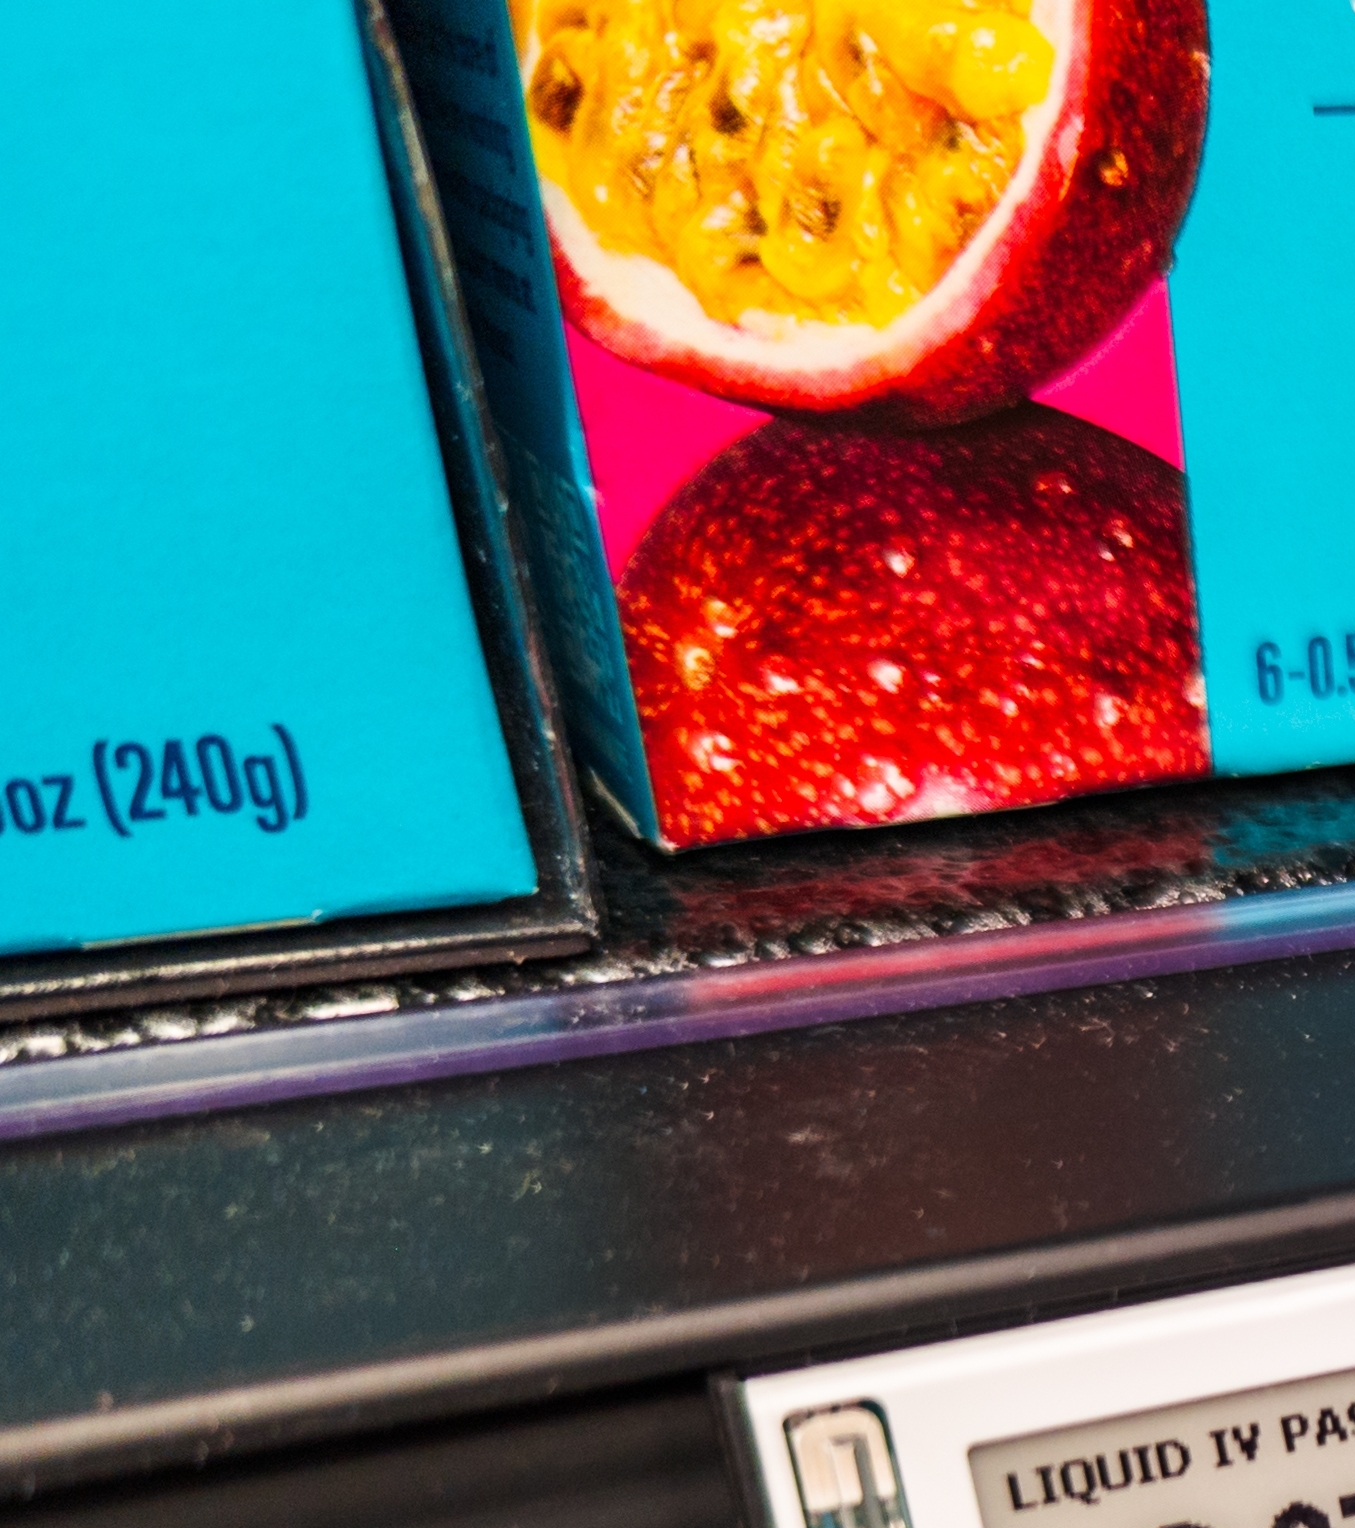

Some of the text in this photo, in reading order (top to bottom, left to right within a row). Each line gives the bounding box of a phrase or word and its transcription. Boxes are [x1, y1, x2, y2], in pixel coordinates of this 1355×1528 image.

[0, 723, 310, 839] oz (240g)
[1006, 1440, 1191, 1511] LIQUID
[1209, 1423, 1260, 1469] IV
